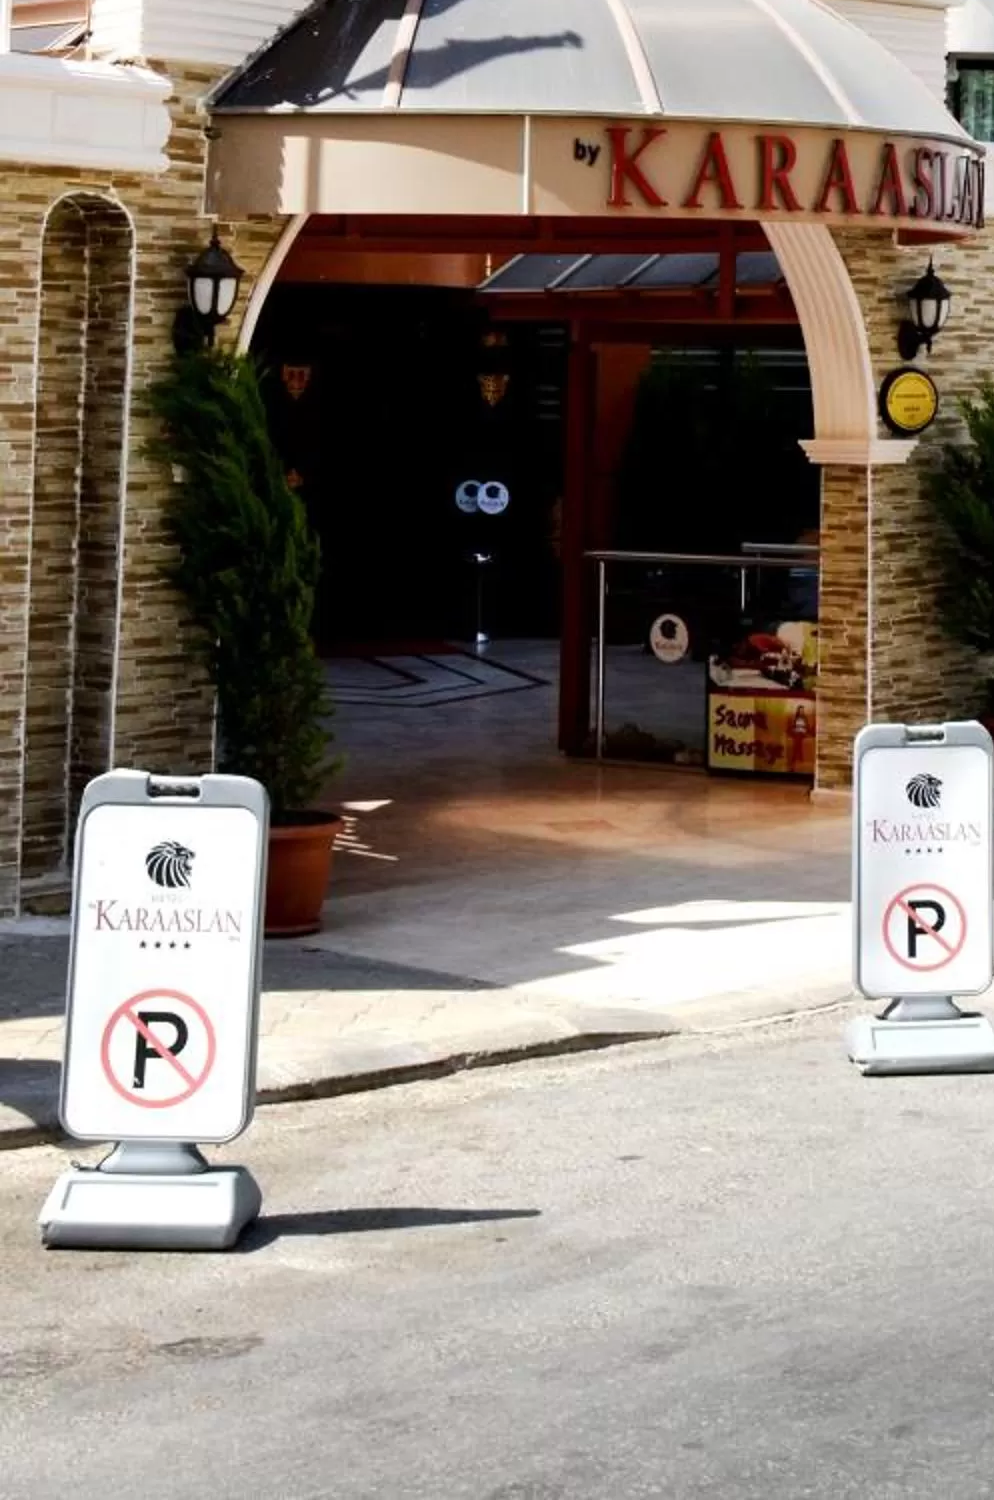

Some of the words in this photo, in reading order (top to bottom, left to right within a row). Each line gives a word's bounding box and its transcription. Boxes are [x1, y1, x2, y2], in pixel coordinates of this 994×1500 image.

[573, 138, 601, 167] by
[604, 126, 985, 229] KARAASLAN
[96, 899, 242, 933] KARAASLAN
[907, 899, 946, 958] P
[132, 1011, 189, 1089] P
